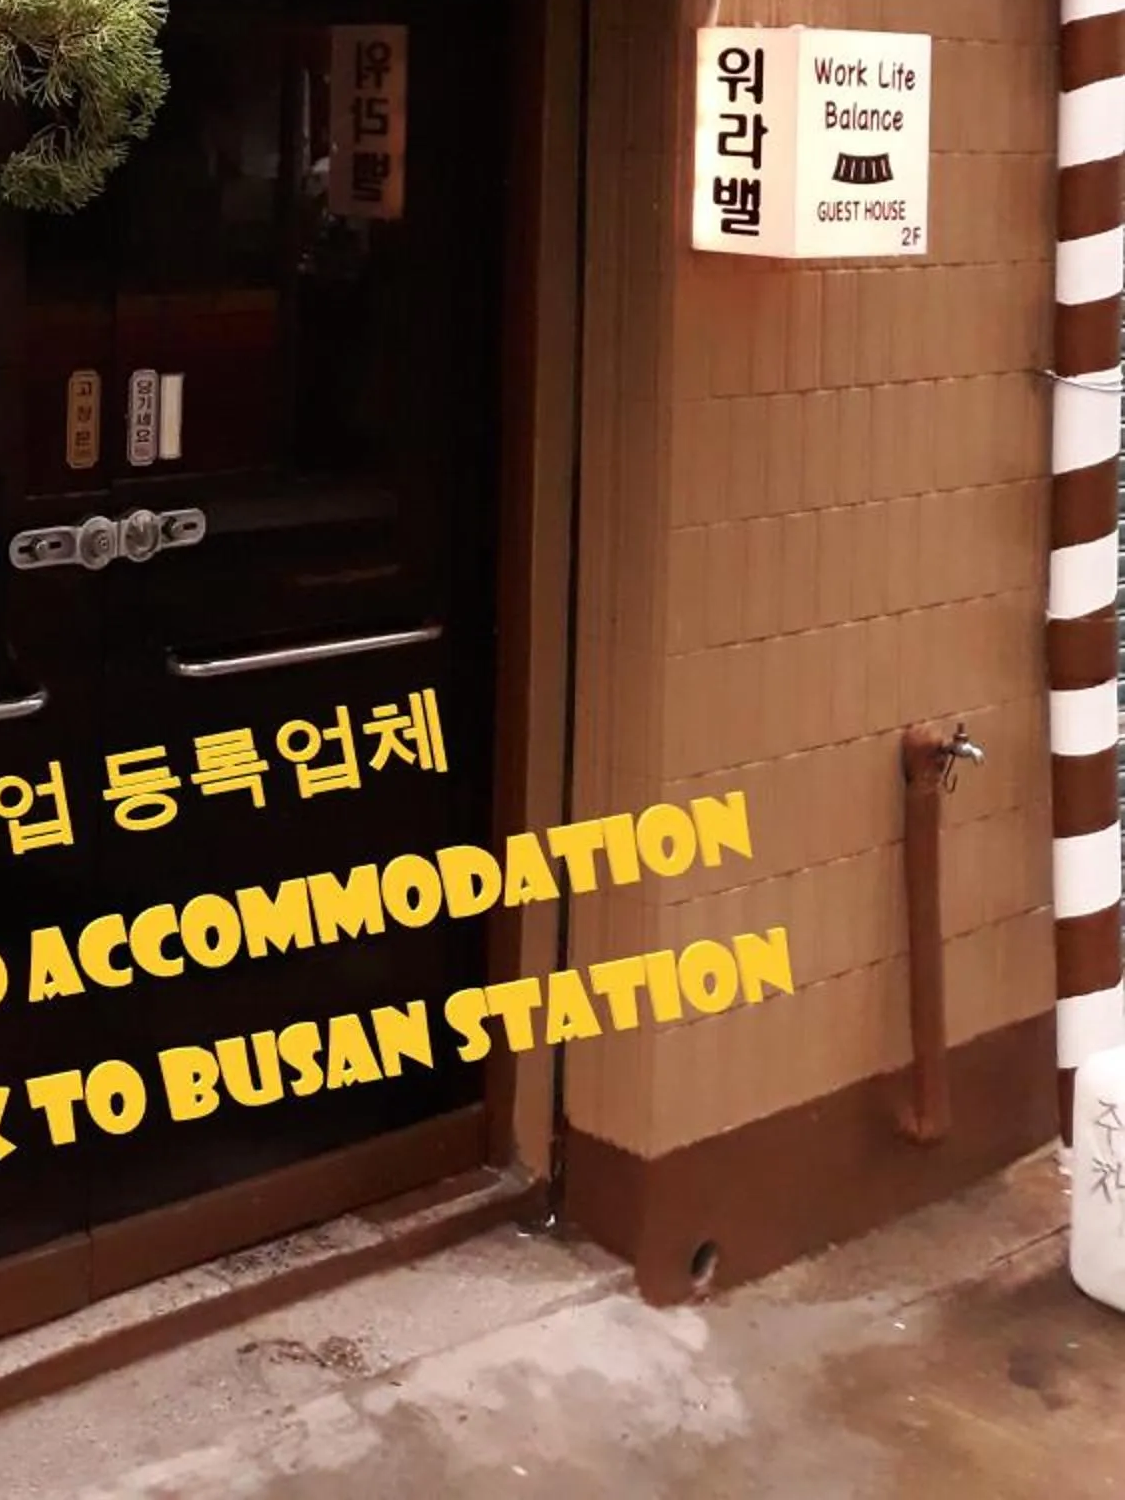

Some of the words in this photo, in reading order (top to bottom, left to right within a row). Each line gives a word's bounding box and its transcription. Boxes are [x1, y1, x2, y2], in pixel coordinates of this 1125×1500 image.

[814, 56, 868, 88] Work
[825, 101, 904, 133] Balance
[711, 47, 769, 237] 워라밸
[817, 201, 860, 222] GUEST
[864, 200, 906, 221] HOUSE
[901, 227, 922, 247] 2F
